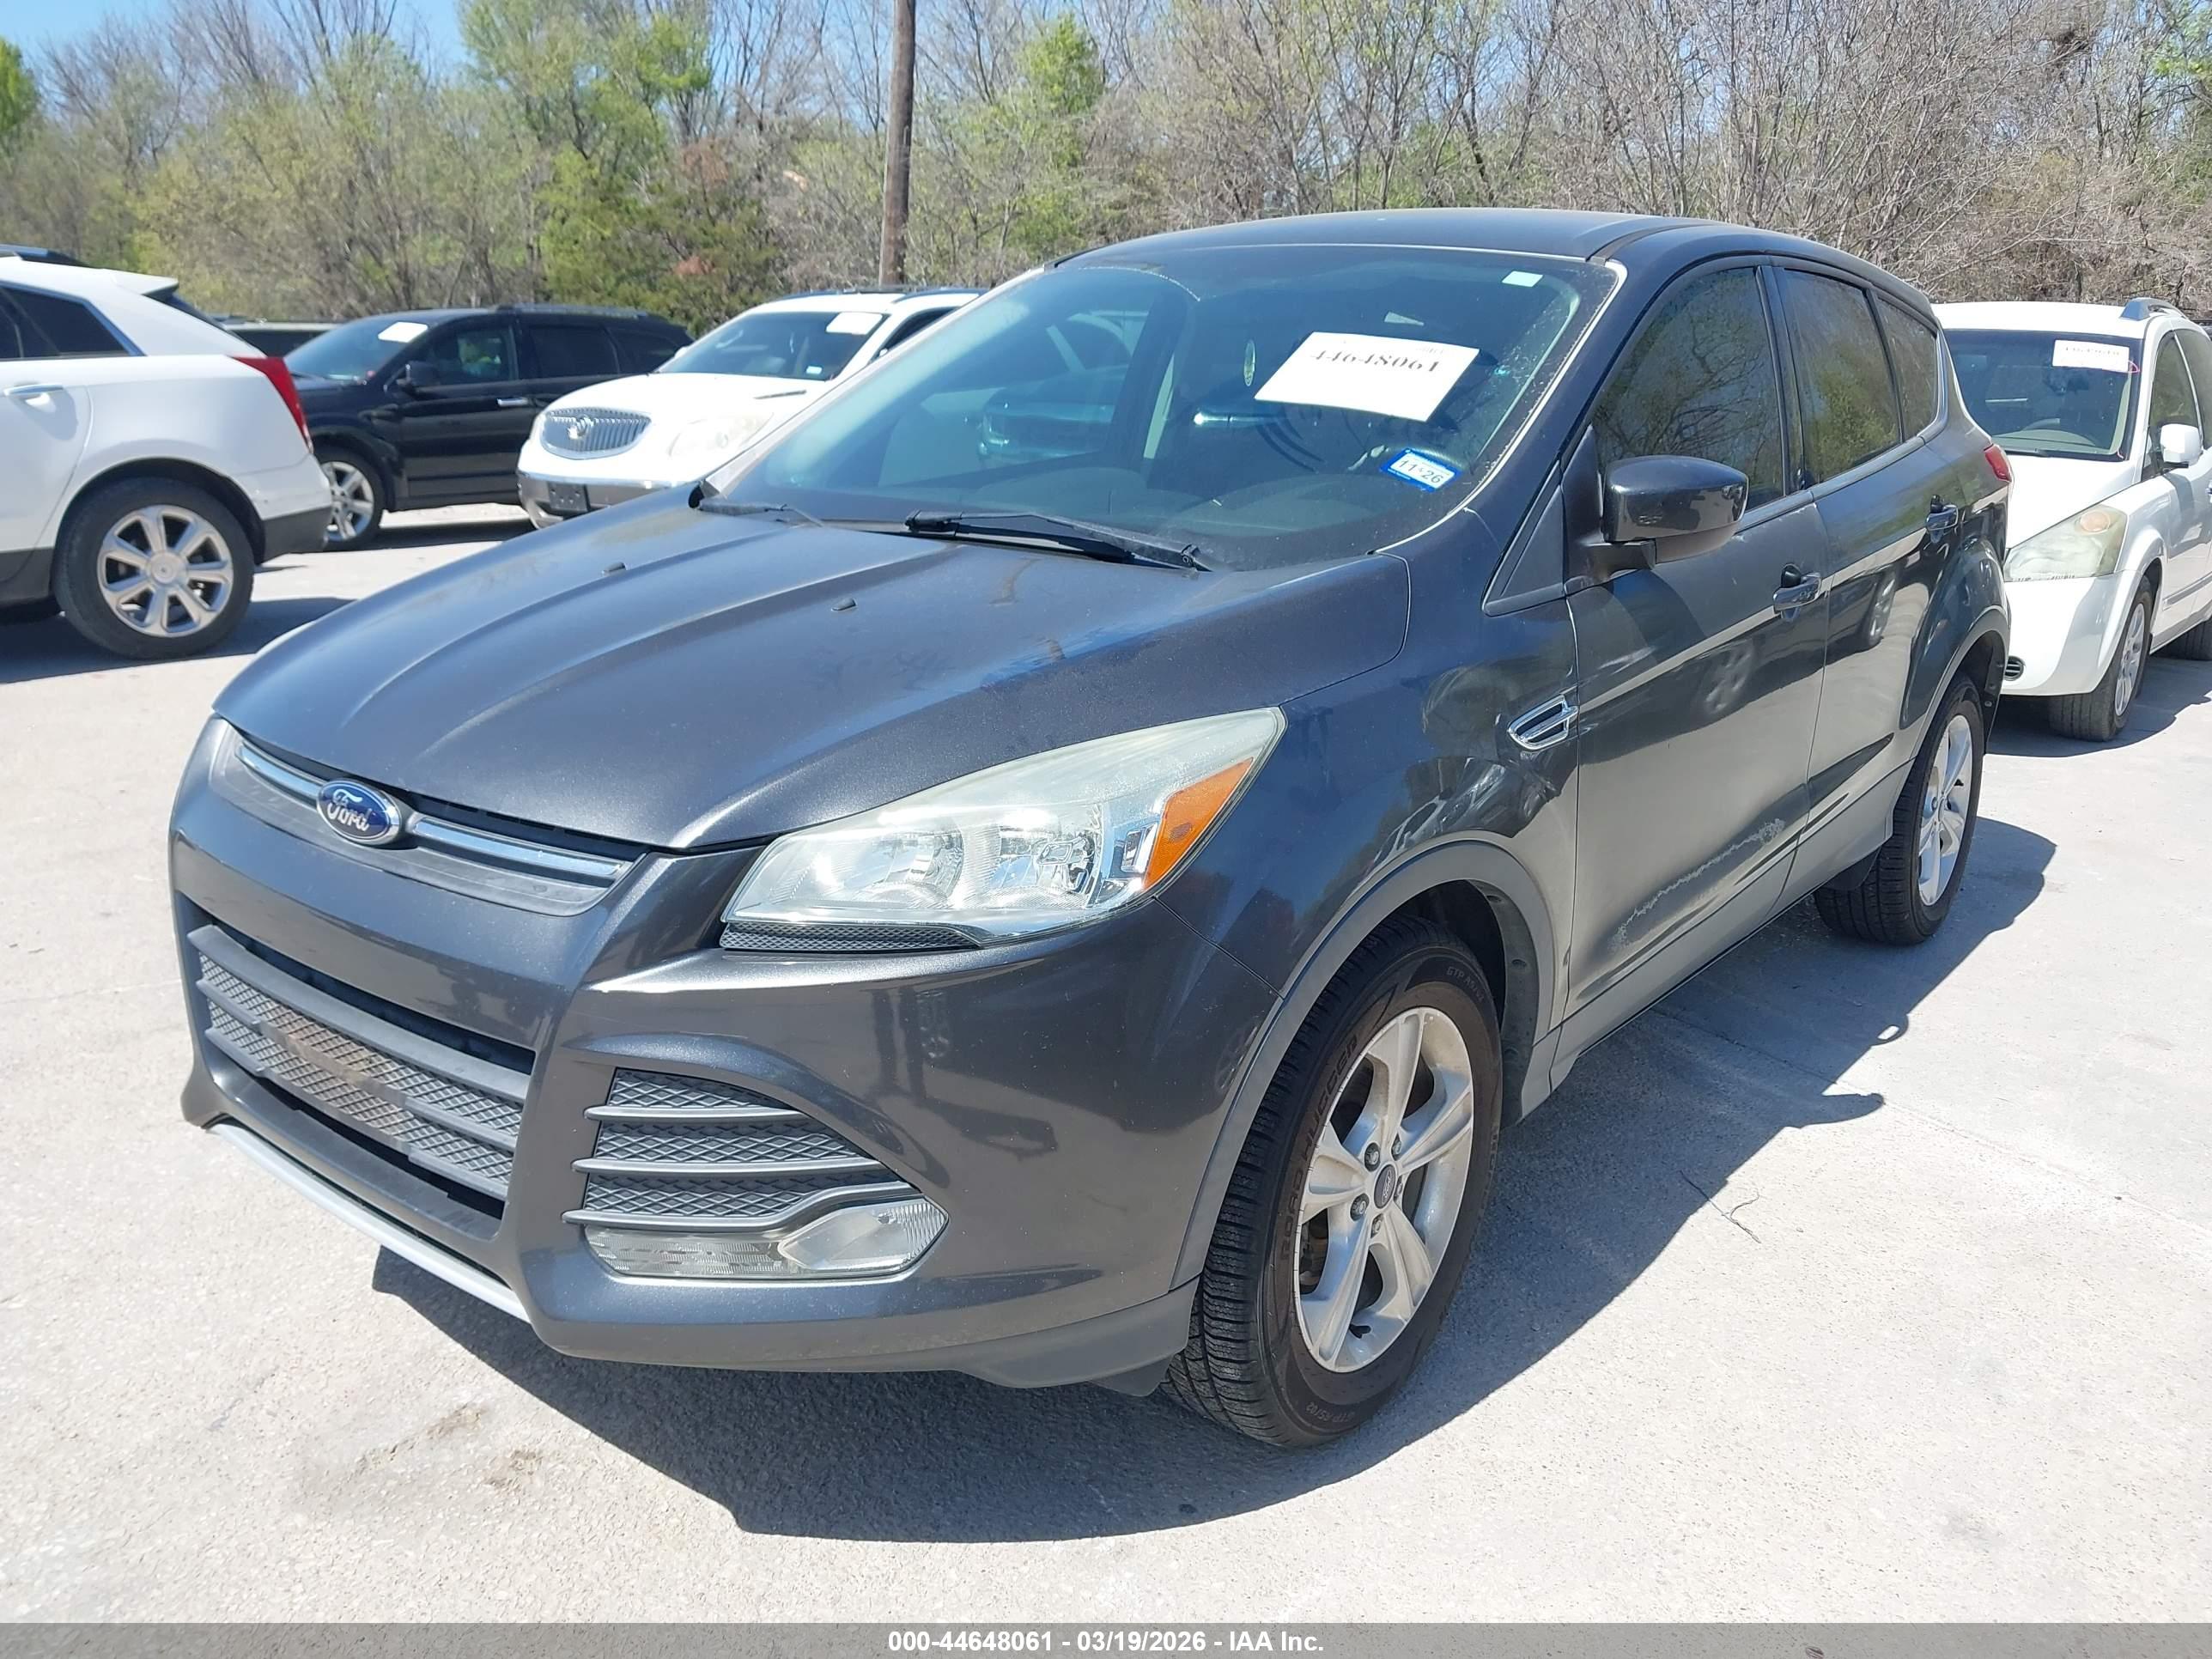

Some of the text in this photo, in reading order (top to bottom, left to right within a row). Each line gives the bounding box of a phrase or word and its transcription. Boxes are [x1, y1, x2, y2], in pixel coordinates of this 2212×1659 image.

[1398, 459, 1419, 472] 11
[1421, 470, 1444, 483] 26
[326, 788, 373, 832] Ford
